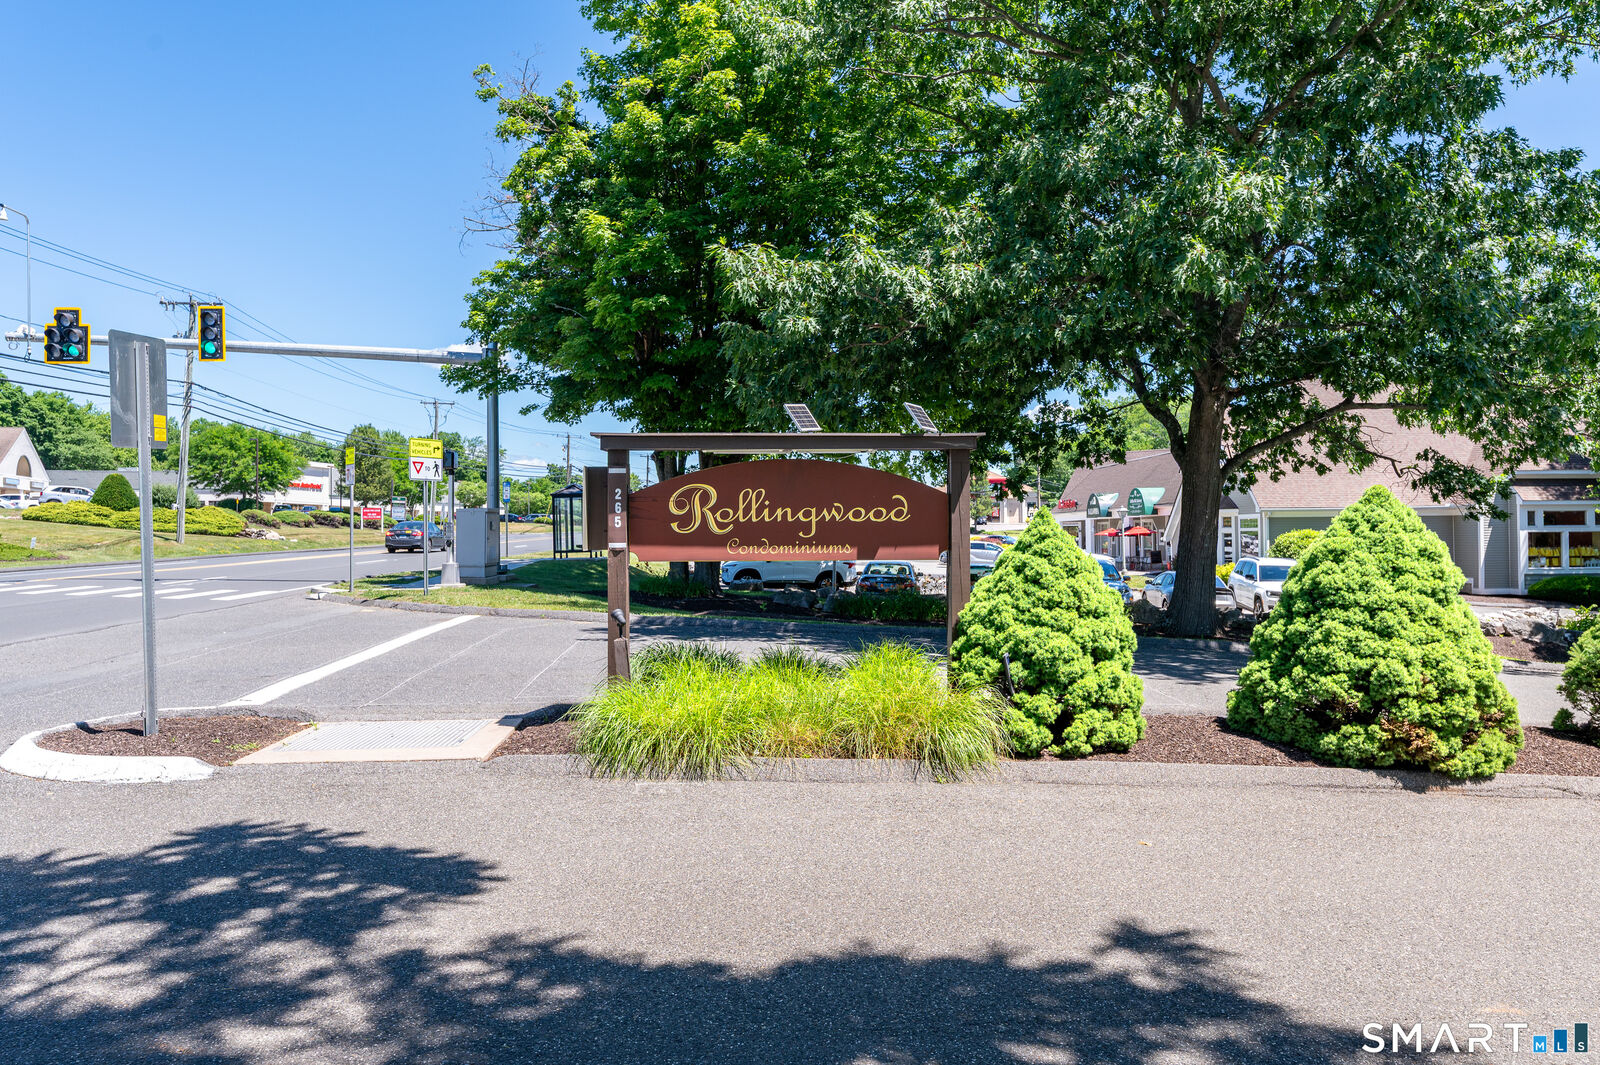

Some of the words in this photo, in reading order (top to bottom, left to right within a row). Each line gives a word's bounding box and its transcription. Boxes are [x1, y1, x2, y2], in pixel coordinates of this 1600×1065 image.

[614, 488, 622, 528] 265
[668, 483, 911, 538] Rollingwood
[726, 537, 854, 555] Condominiums
